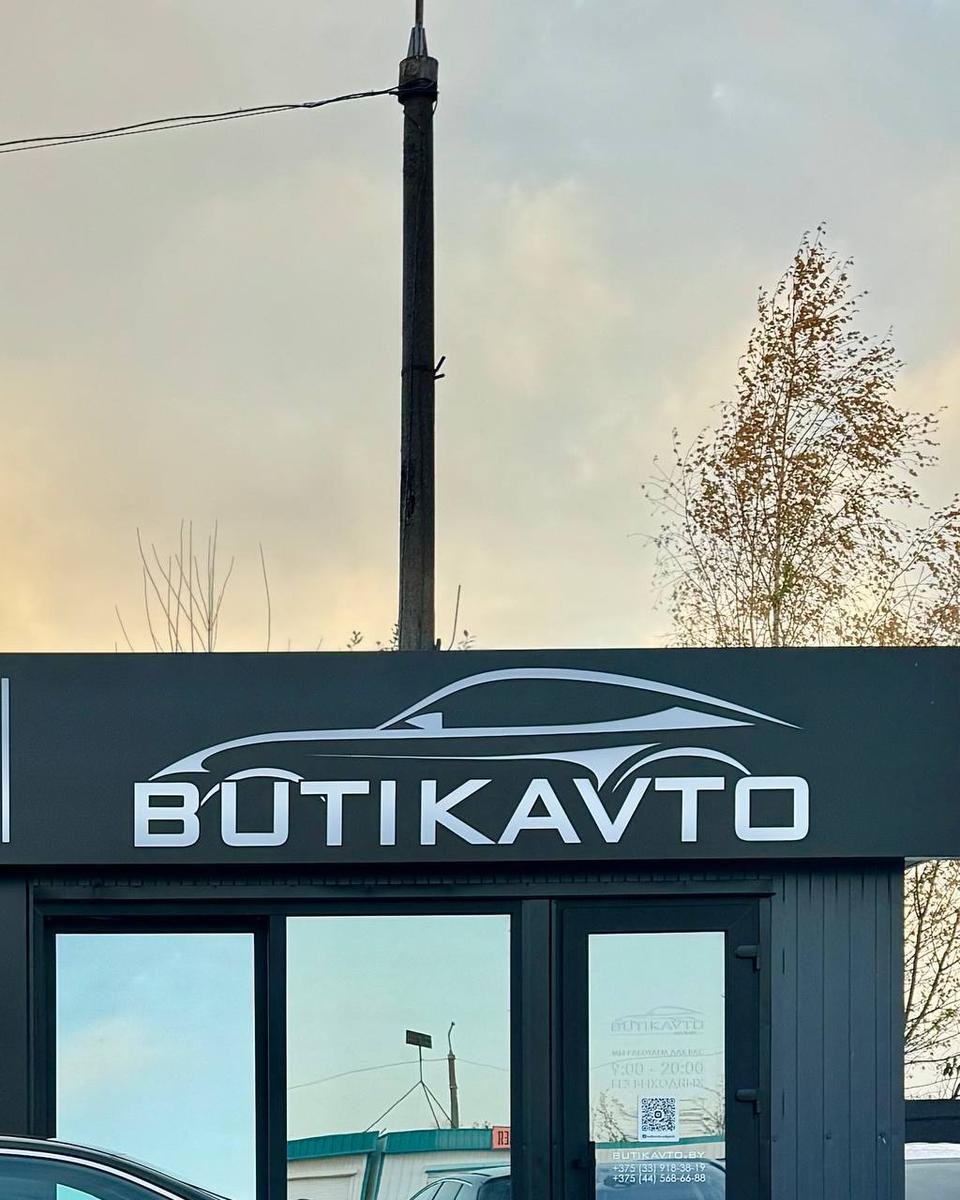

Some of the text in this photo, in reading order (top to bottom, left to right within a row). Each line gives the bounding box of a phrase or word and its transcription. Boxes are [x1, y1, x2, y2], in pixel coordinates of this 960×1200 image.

[133, 775, 810, 848] BUTIKAVTO
[612, 1151, 705, 1160] BUTIKAVTO.BY
[612, 1163, 706, 1175] +375 (33) 918-38-19
[612, 1173, 706, 1185] +375 (44) 568-66-88
